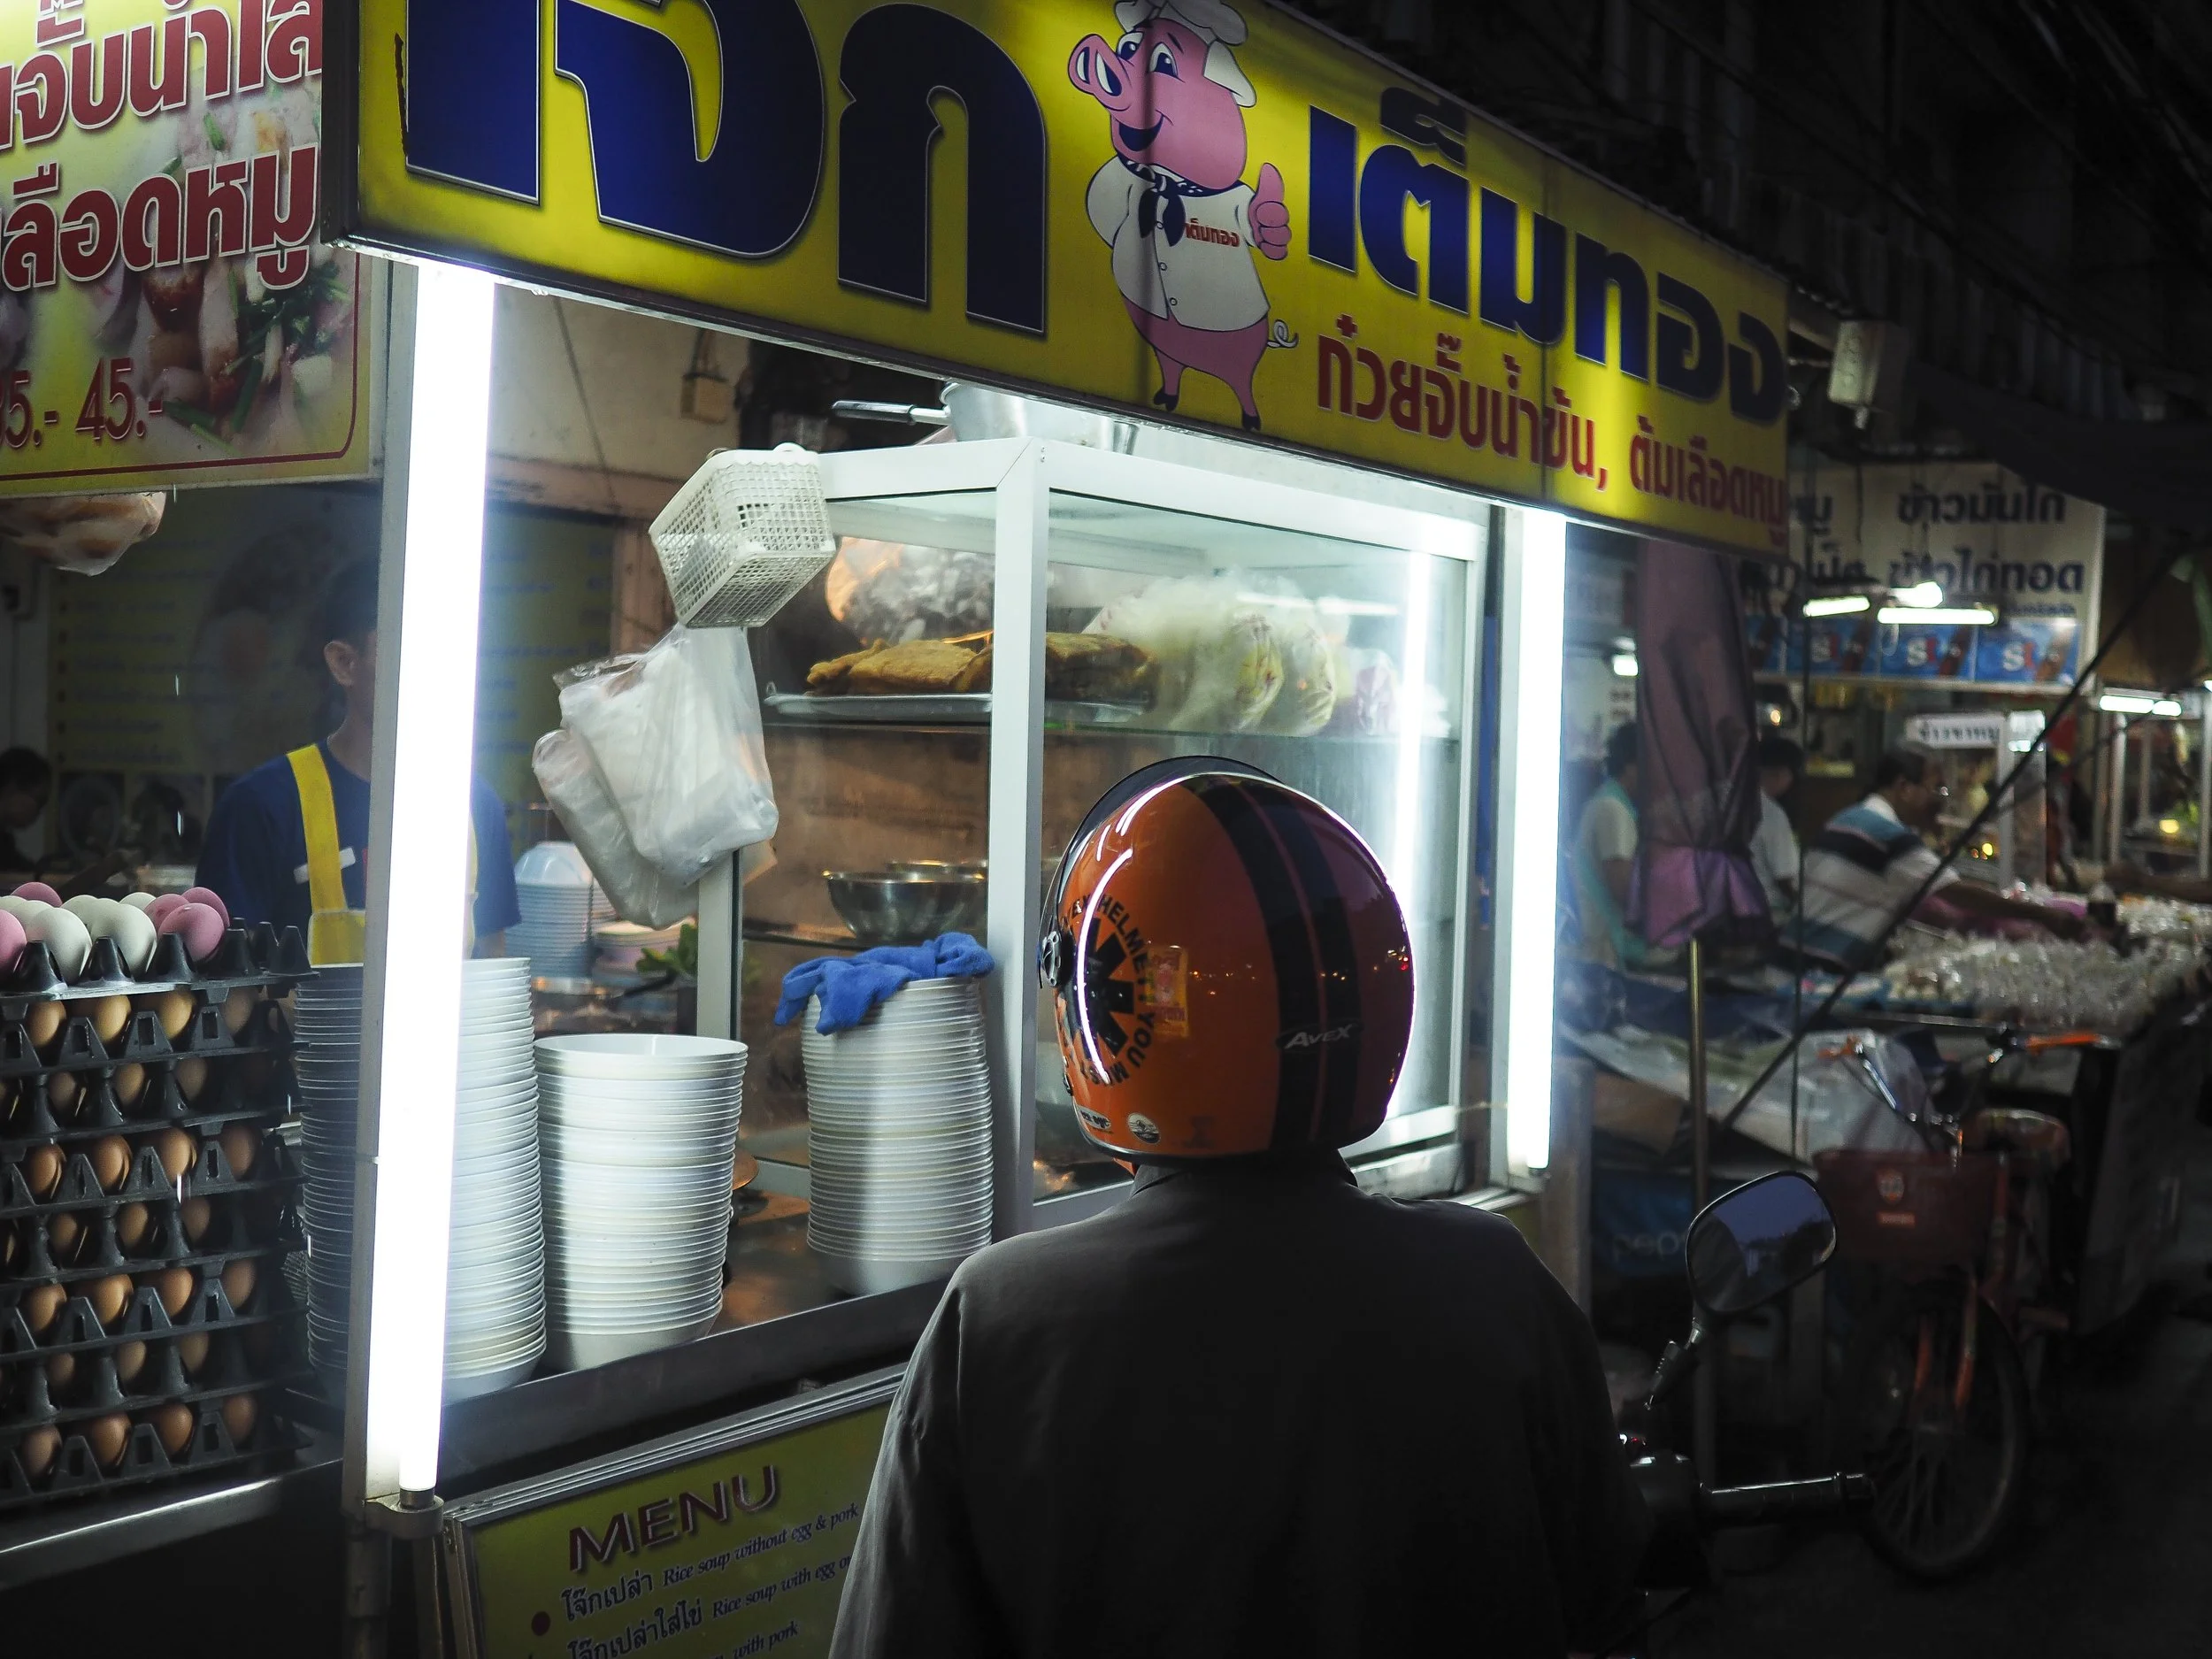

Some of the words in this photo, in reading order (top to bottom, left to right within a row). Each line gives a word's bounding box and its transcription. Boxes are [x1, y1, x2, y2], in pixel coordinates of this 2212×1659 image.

[0, 144, 319, 290] ลือดหมู
[1309, 88, 1786, 427] เต็มทอง
[0, 369, 59, 448] 5.-
[1127, 1011, 1155, 1067] YOU
[1612, 1231, 1688, 1263] pep
[569, 1465, 776, 1572] MENU
[663, 1565, 694, 1587] Rice
[697, 1552, 731, 1574] soup
[734, 1529, 788, 1560] without
[791, 1521, 812, 1543] egg
[815, 1514, 828, 1532] &
[830, 1502, 860, 1531] pork
[561, 1570, 653, 1622] โจ๊กเปล่า
[712, 1598, 742, 1619] Rice
[745, 1583, 778, 1604] soup
[781, 1567, 811, 1592] with
[815, 1561, 836, 1582] egg
[733, 1633, 765, 1659] with
[768, 1620, 800, 1651] pork
